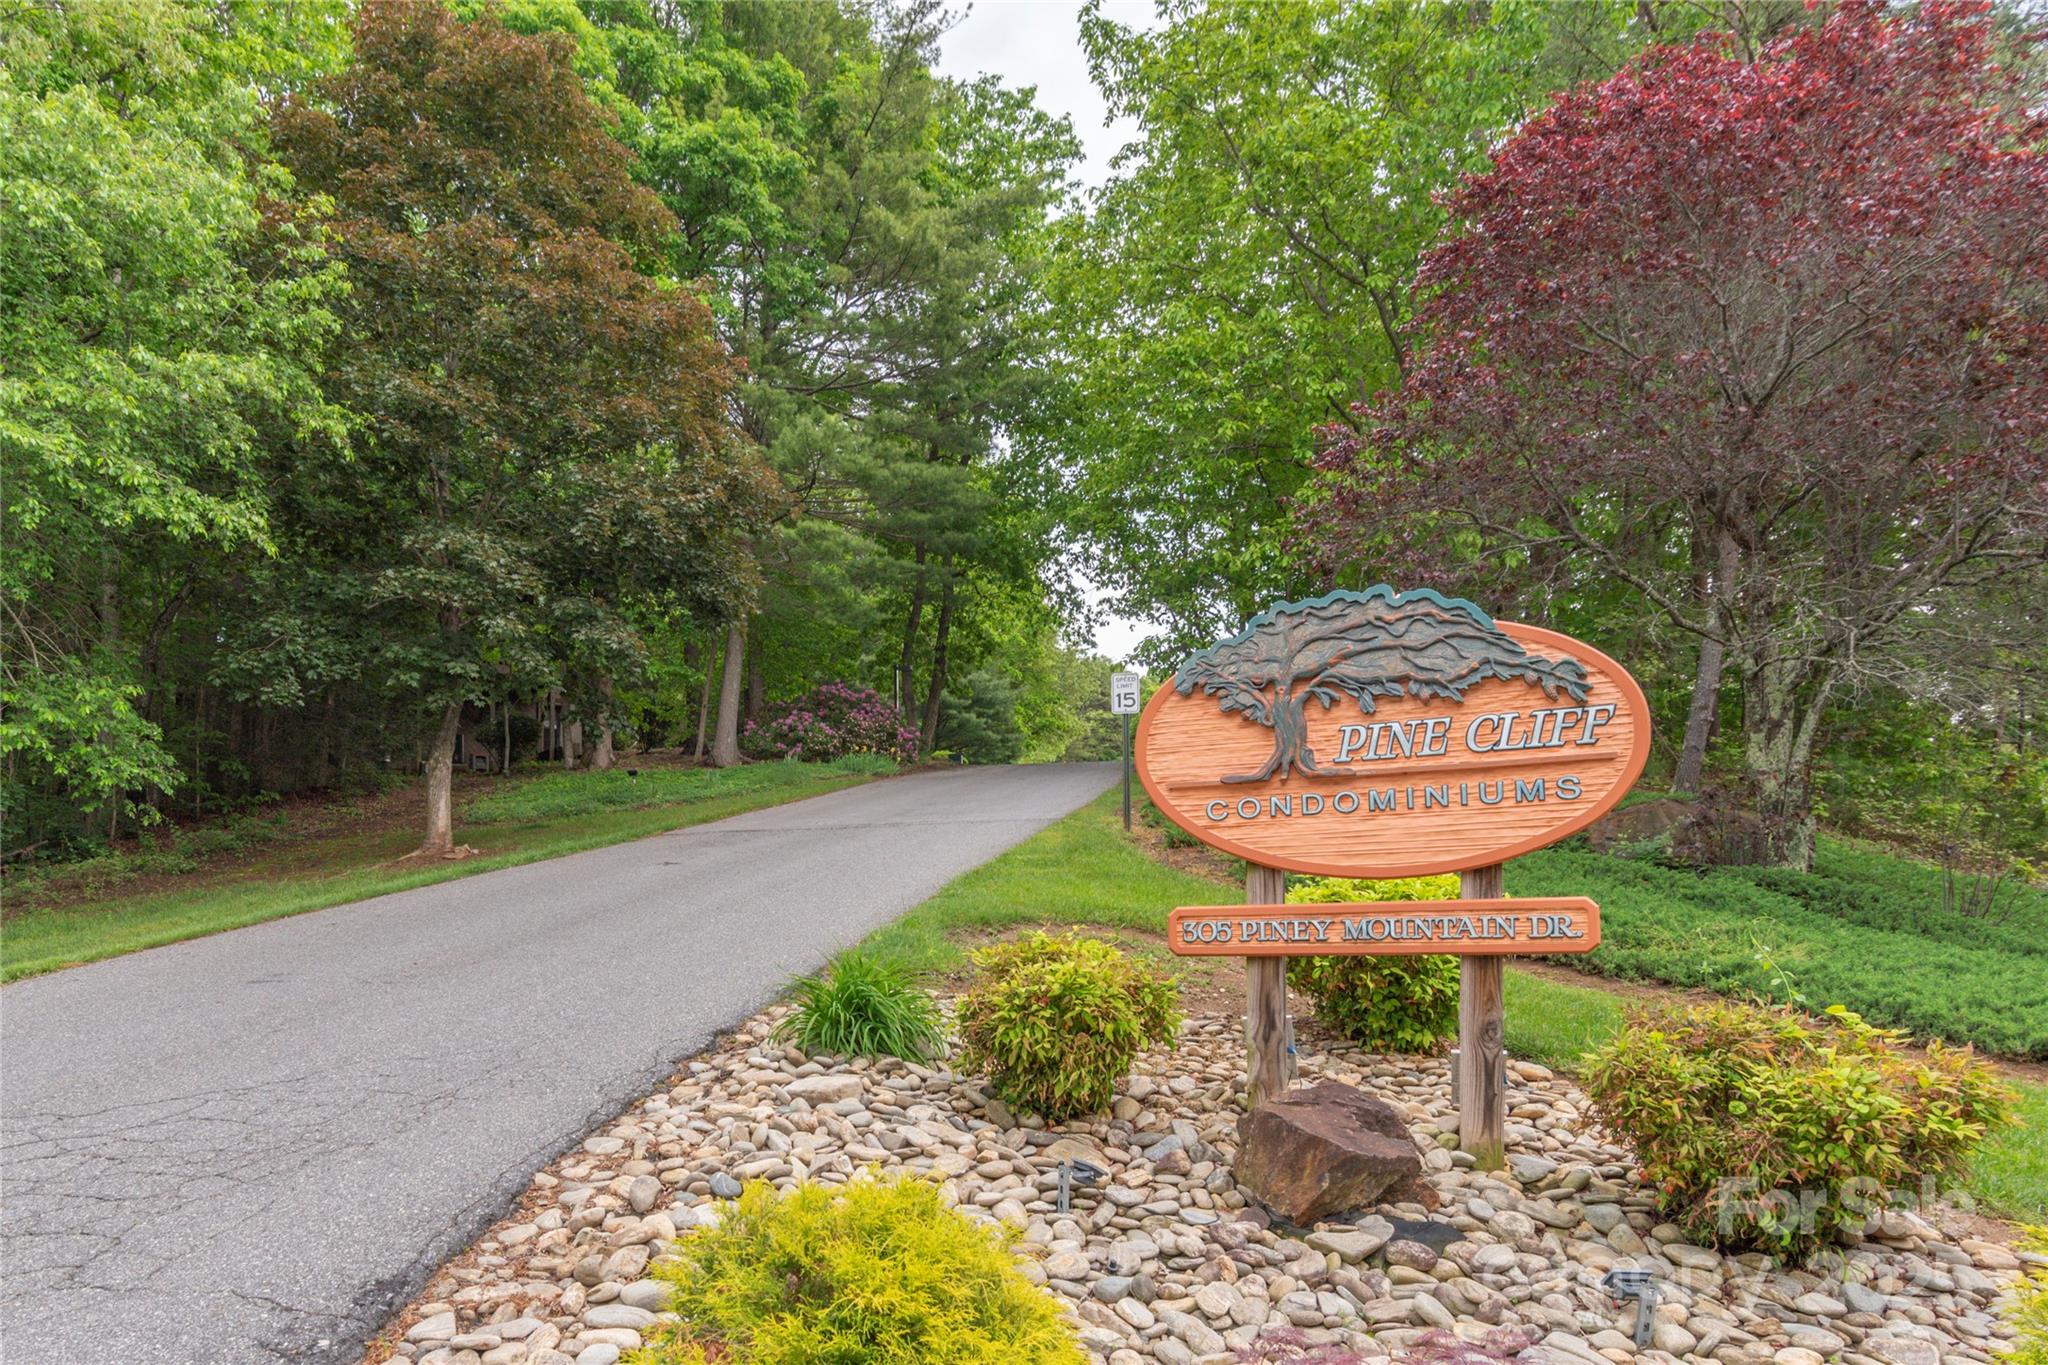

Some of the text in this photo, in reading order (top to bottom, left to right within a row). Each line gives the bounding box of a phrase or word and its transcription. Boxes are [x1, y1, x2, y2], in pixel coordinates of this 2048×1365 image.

[1116, 692, 1136, 708] 15
[1333, 703, 1616, 763] PINE CLIFF
[1206, 775, 1583, 821] CONDOMINIUMS
[1182, 914, 1584, 943] 305 PINEY MOUNTAIN DR.
